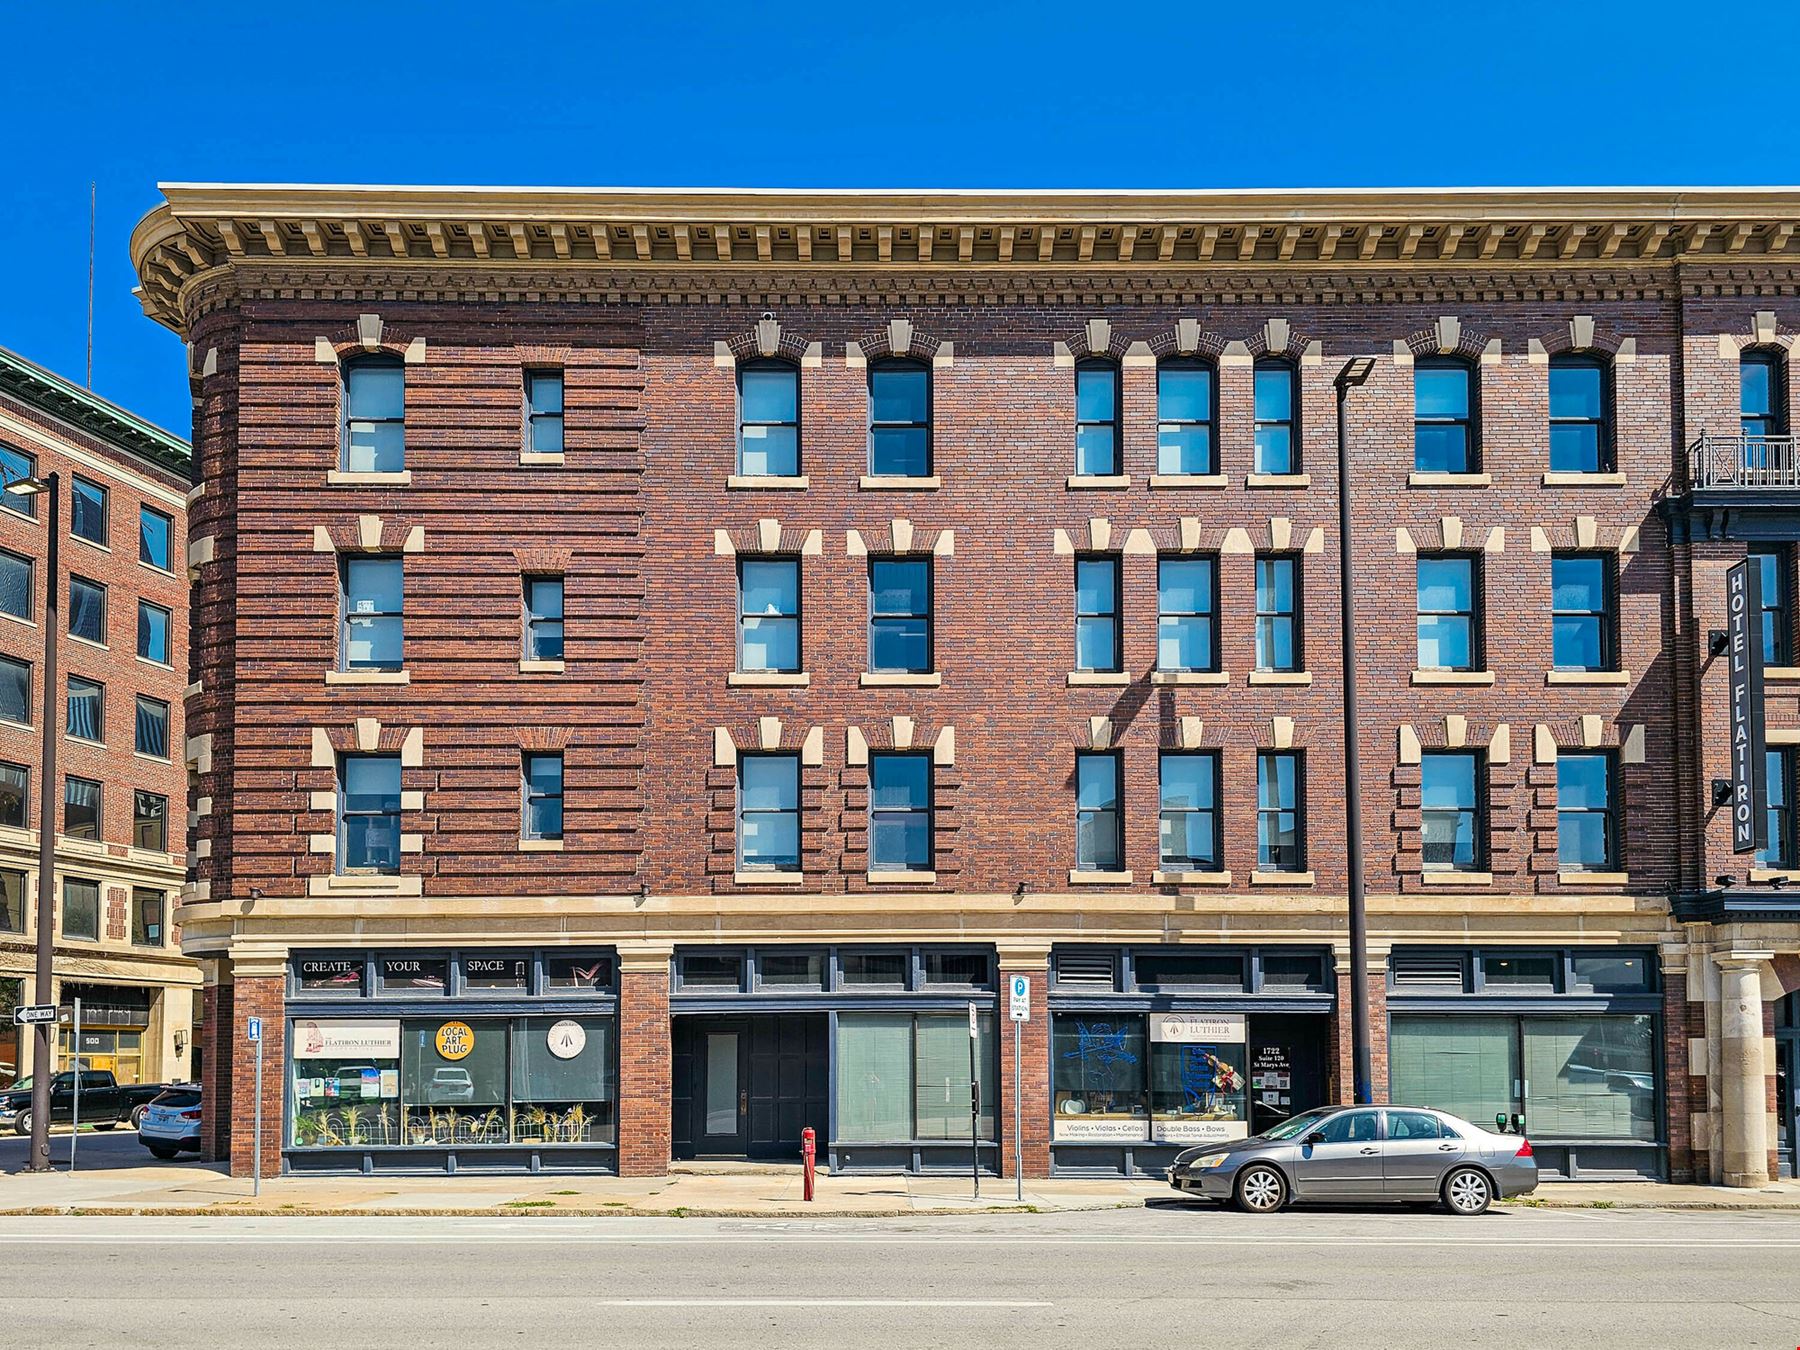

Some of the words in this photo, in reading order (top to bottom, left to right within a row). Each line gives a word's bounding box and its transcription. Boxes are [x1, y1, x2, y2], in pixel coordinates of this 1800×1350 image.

[1731, 572, 1744, 673] HOTEL
[1735, 683, 1750, 842] FLATIRON
[303, 961, 352, 972] CREATE
[386, 961, 421, 972] YOUR
[467, 960, 505, 971] SPACE
[40, 1010, 53, 1018] WAY
[441, 1027, 468, 1036] LOCAL
[1189, 1026, 1230, 1034] LUTHIER
[325, 1039, 359, 1047] FLATIRON
[360, 1039, 392, 1047] LUTHIER
[445, 1036, 462, 1045] ART
[441, 1044, 468, 1054] PLUG
[1263, 1047, 1280, 1055] 1722
[1260, 1062, 1278, 1070] Marys
[1066, 1124, 1090, 1132] Violins
[1094, 1124, 1117, 1132] Violas
[1122, 1124, 1144, 1132] Cellos
